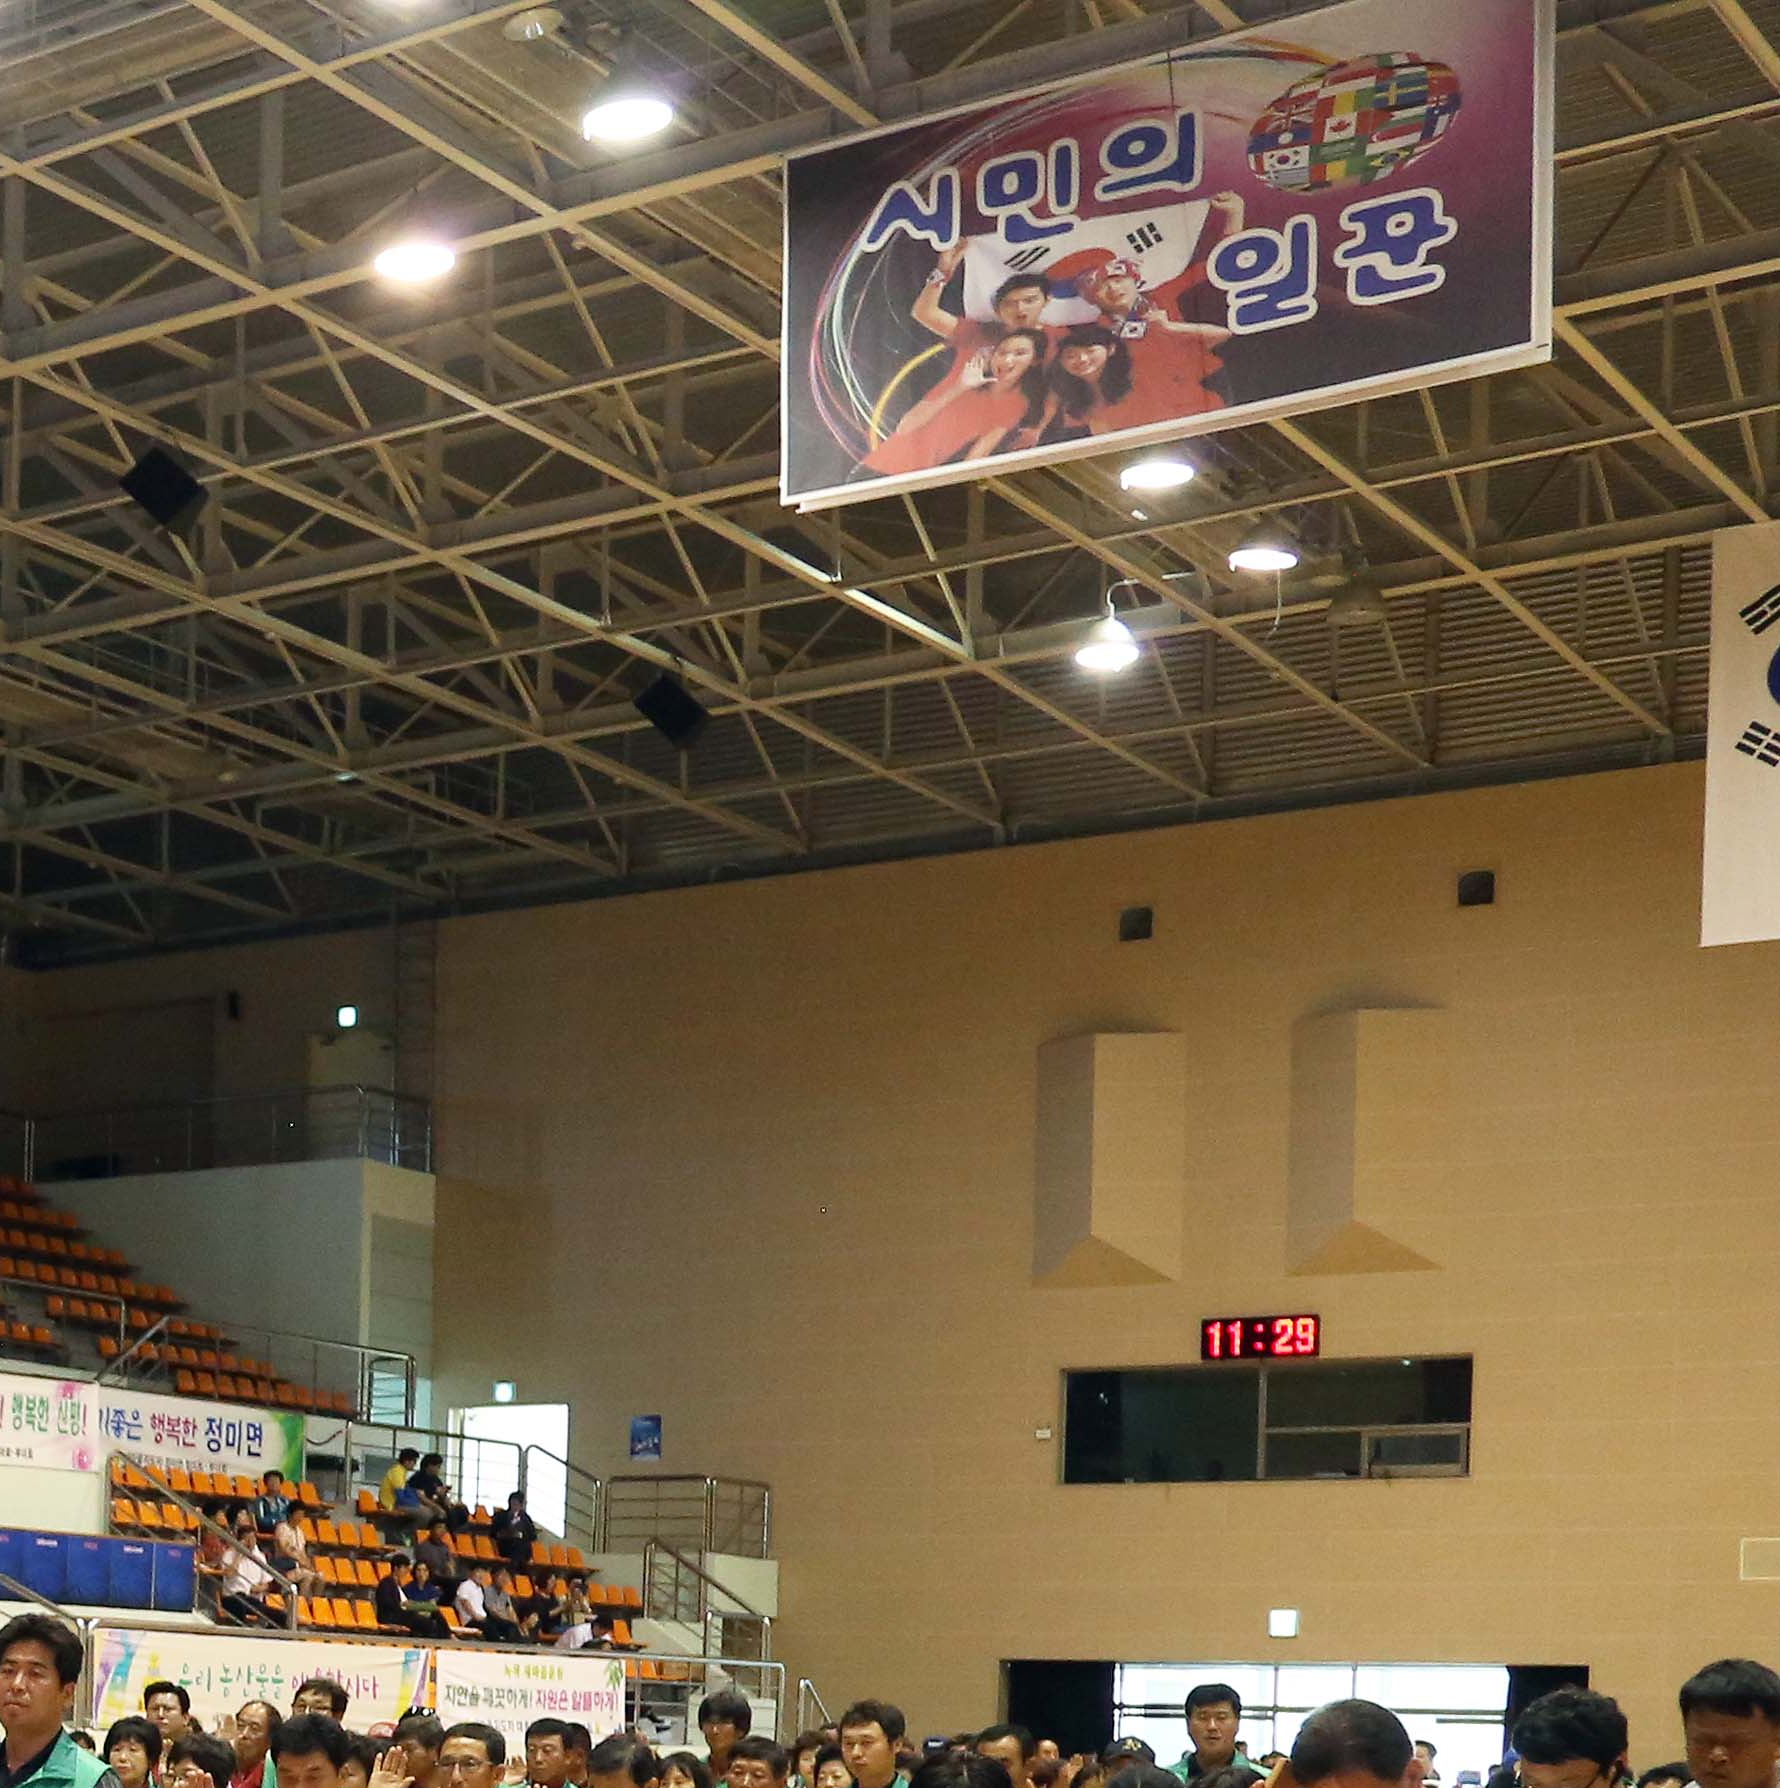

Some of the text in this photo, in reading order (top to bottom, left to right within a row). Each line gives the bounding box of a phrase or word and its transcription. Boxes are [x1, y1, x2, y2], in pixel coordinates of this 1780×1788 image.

[862, 106, 1205, 252] 시민의
[1209, 187, 1458, 333] 일꾼
[1205, 1317, 1315, 1357] 11:29
[12, 1393, 50, 1433] 행복한
[151, 1413, 198, 1448] 행복한
[205, 1416, 263, 1457] 정미면
[178, 1664, 213, 1693] 우리
[220, 1663, 285, 1700] 농산물을
